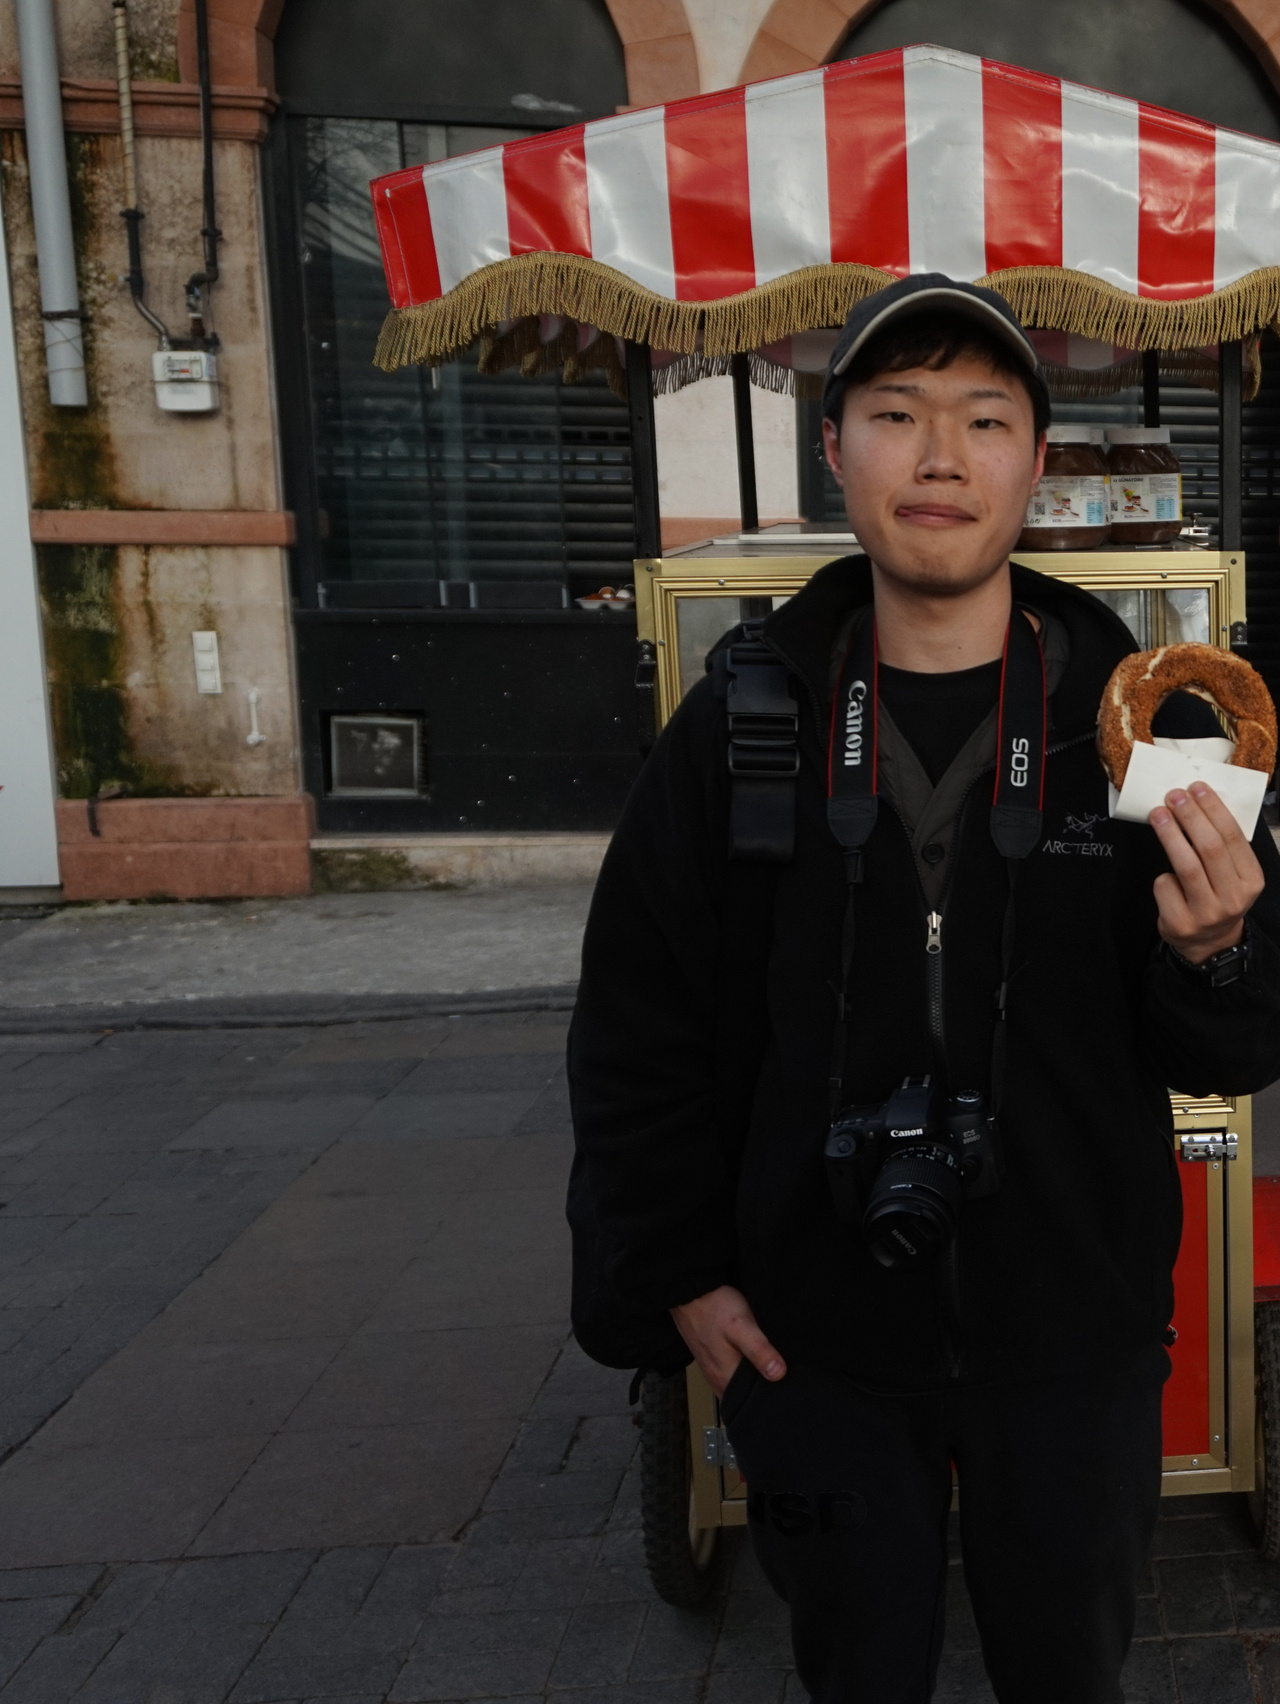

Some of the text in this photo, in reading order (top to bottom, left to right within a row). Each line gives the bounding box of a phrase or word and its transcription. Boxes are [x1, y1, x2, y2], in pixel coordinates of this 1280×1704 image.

[844, 680, 868, 766] Canon
[1010, 737, 1030, 787] EOS
[890, 1127, 924, 1138] Canon
[891, 1229, 917, 1255] Canon
